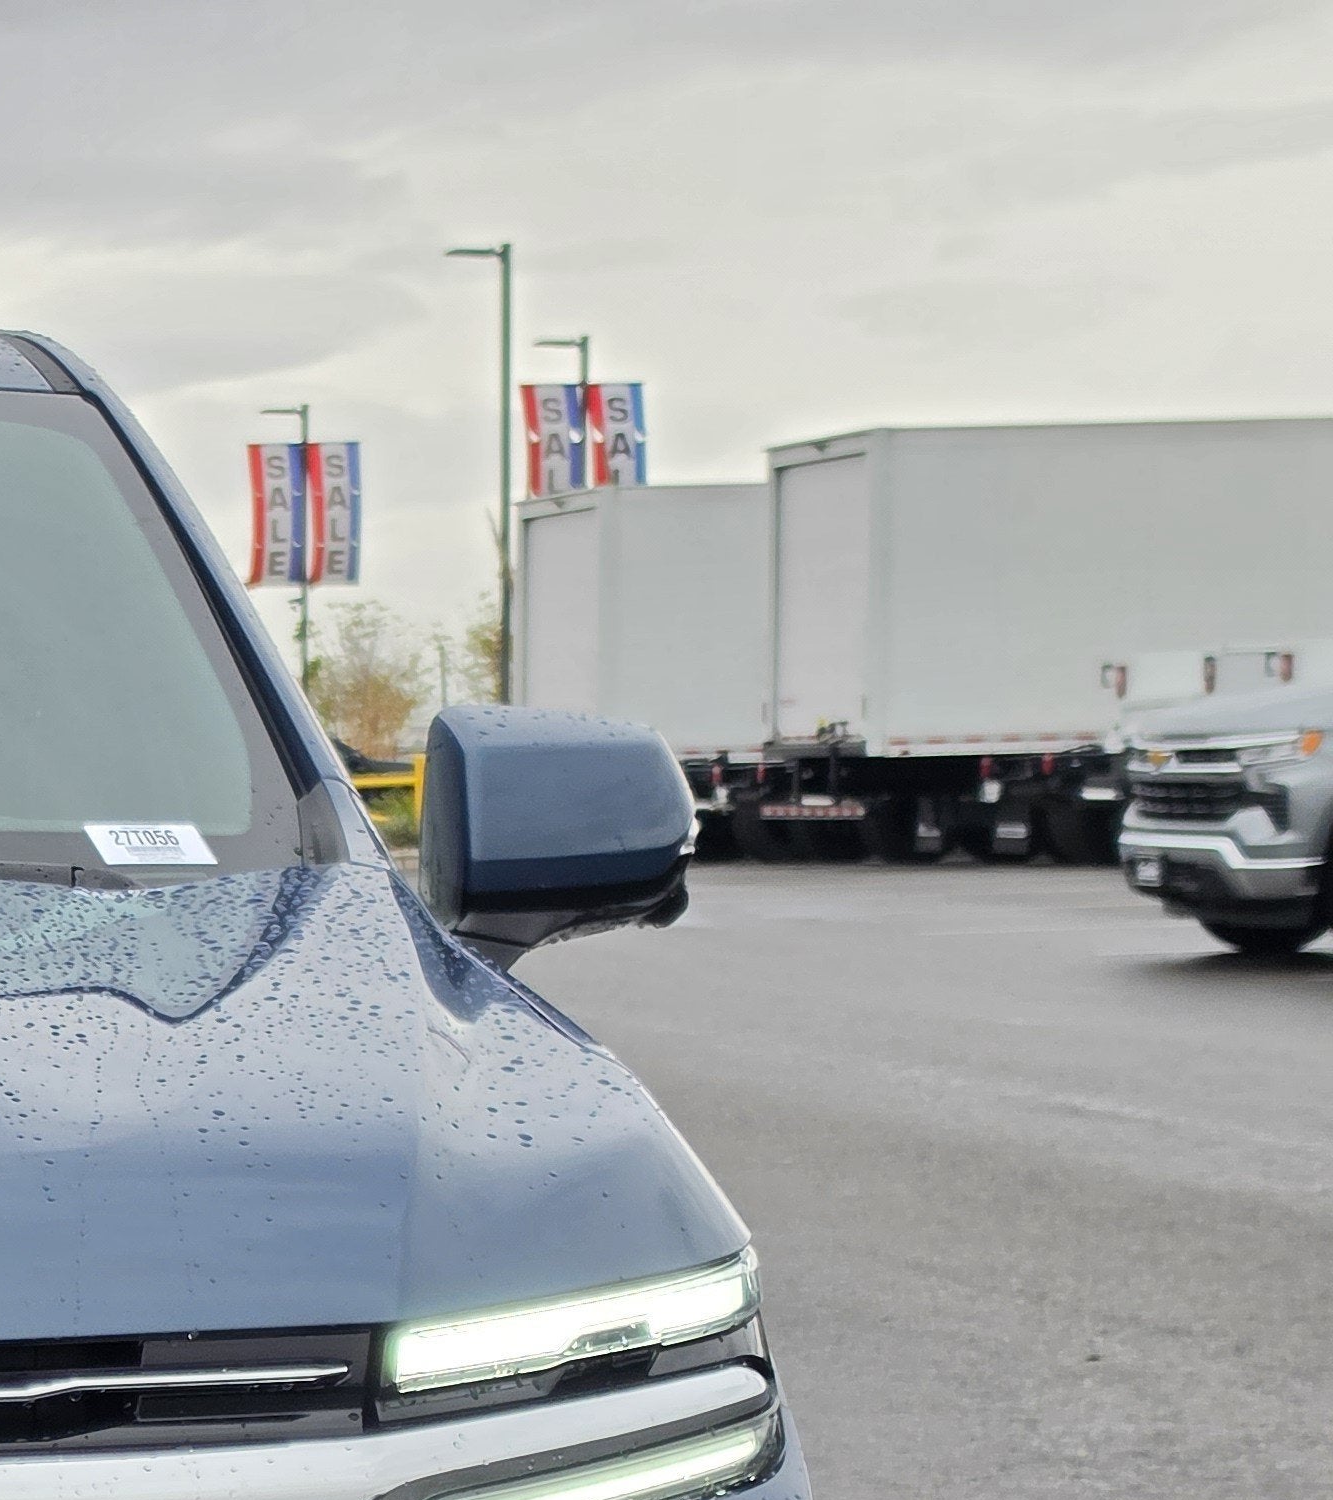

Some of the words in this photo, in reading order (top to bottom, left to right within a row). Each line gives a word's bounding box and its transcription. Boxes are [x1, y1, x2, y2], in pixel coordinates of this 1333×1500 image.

[542, 397, 566, 495] SAL
[267, 455, 288, 577] SALE
[325, 454, 347, 575] SALE
[108, 830, 180, 846] 27T056
